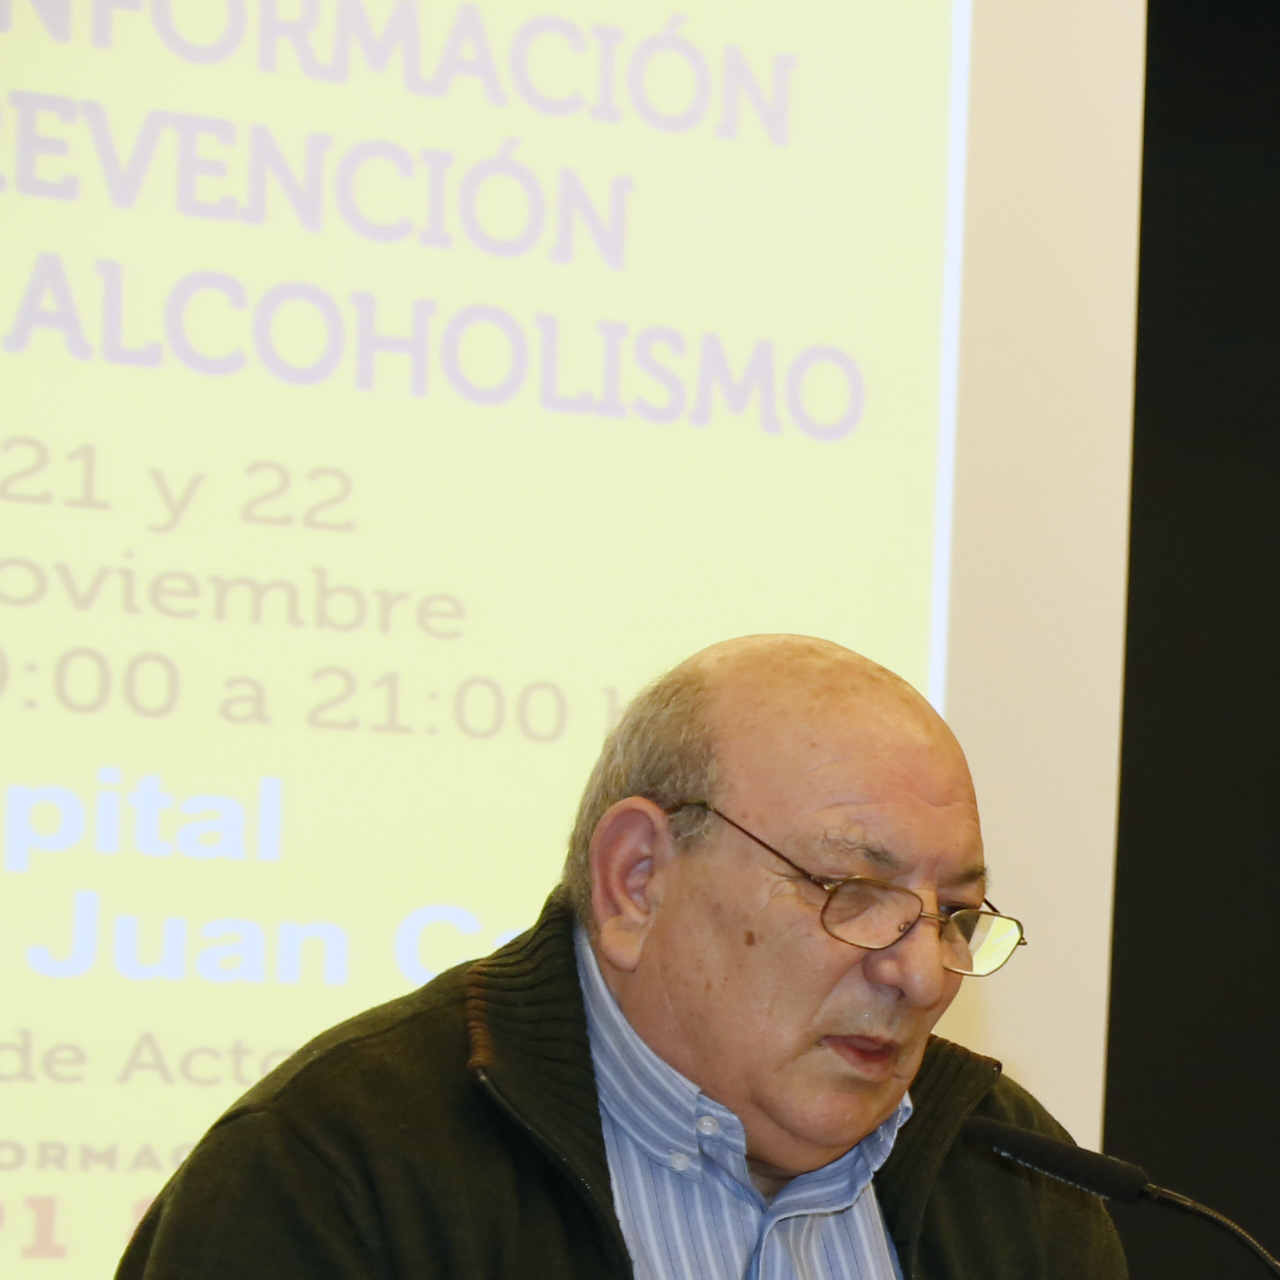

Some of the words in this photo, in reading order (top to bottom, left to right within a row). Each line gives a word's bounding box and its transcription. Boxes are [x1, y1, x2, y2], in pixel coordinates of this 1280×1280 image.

[2, 252, 867, 442] ALCOHOLISMO
[0, 436, 112, 510] 21
[147, 467, 206, 533] y
[240, 460, 356, 532] 22
[218, 670, 272, 725] a
[307, 665, 569, 744] 21:00
[25, 889, 349, 986] Juan
